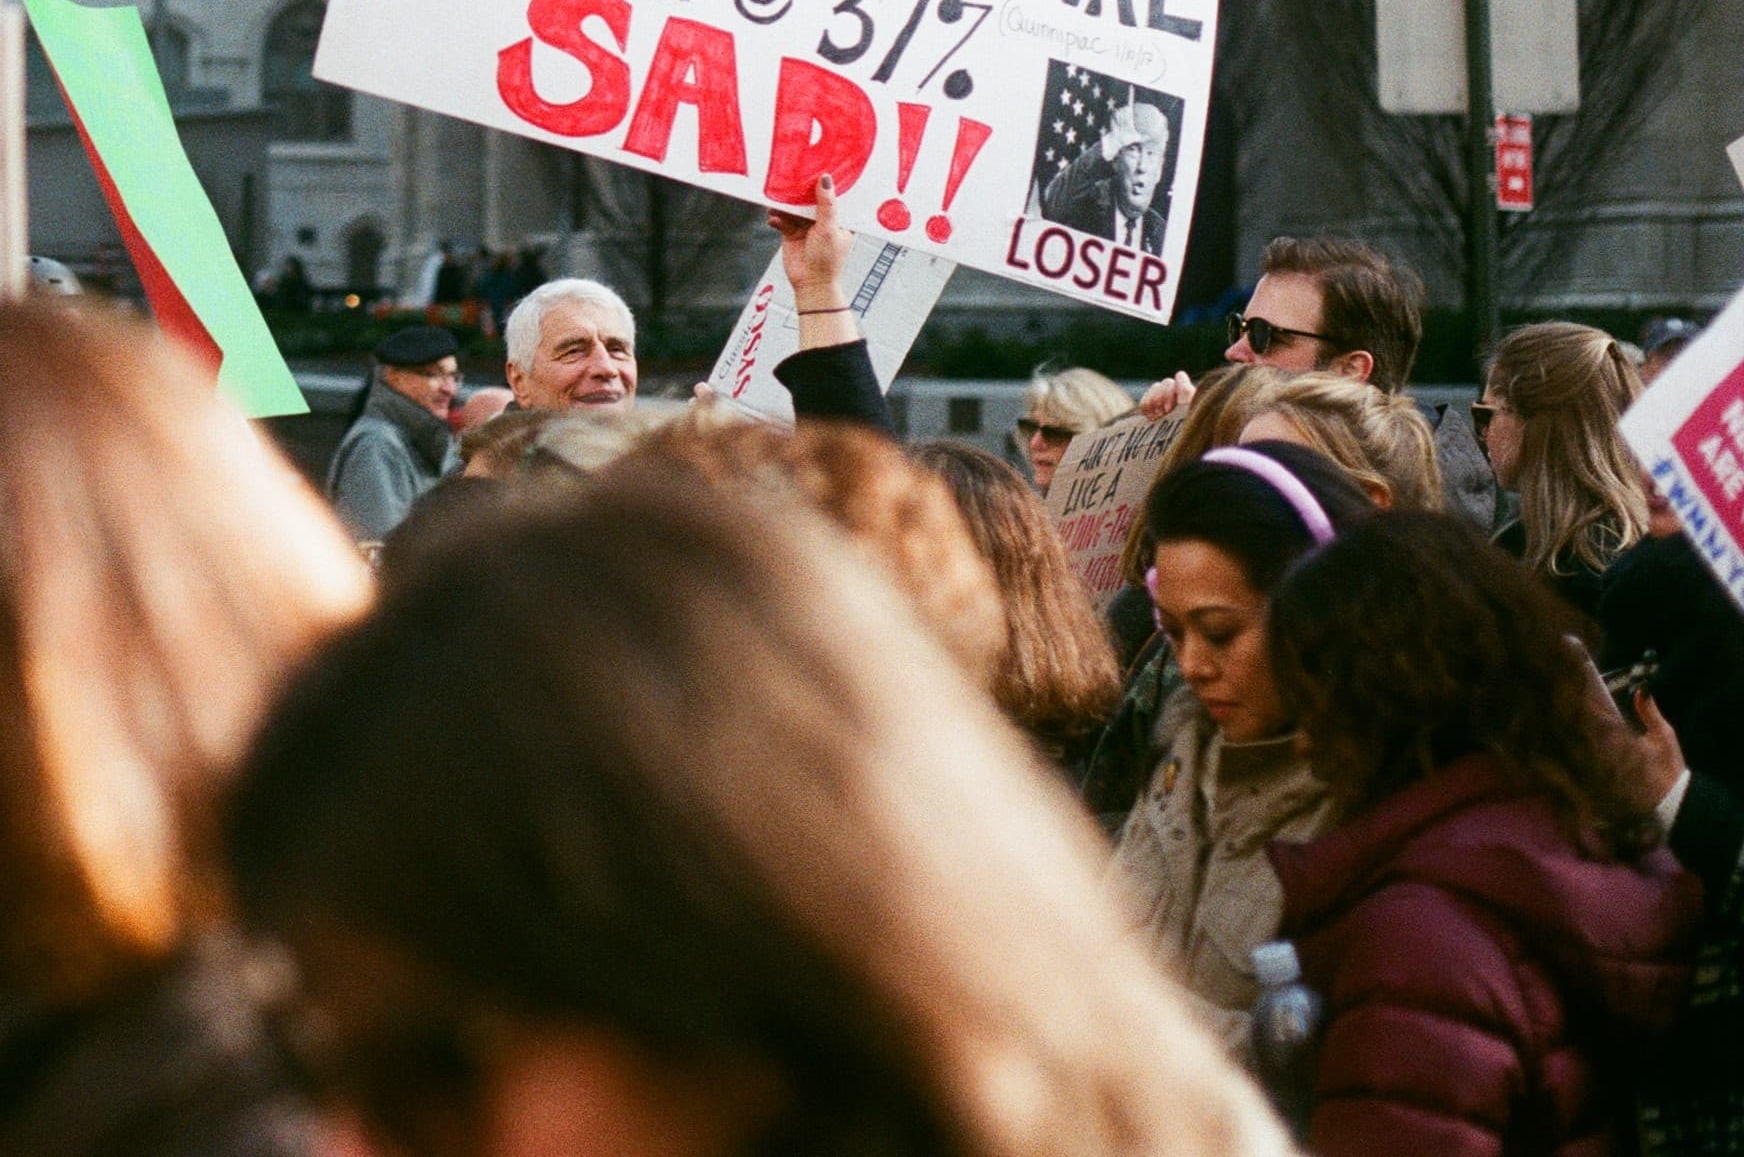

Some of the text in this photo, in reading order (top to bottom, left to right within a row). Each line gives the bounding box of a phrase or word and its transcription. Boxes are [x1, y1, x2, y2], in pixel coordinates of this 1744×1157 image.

[1005, 216, 1168, 311] LOSER
[1116, 423, 1156, 463] NO
[1696, 433, 1744, 502] ARE
[1062, 467, 1123, 517] LIKE A
